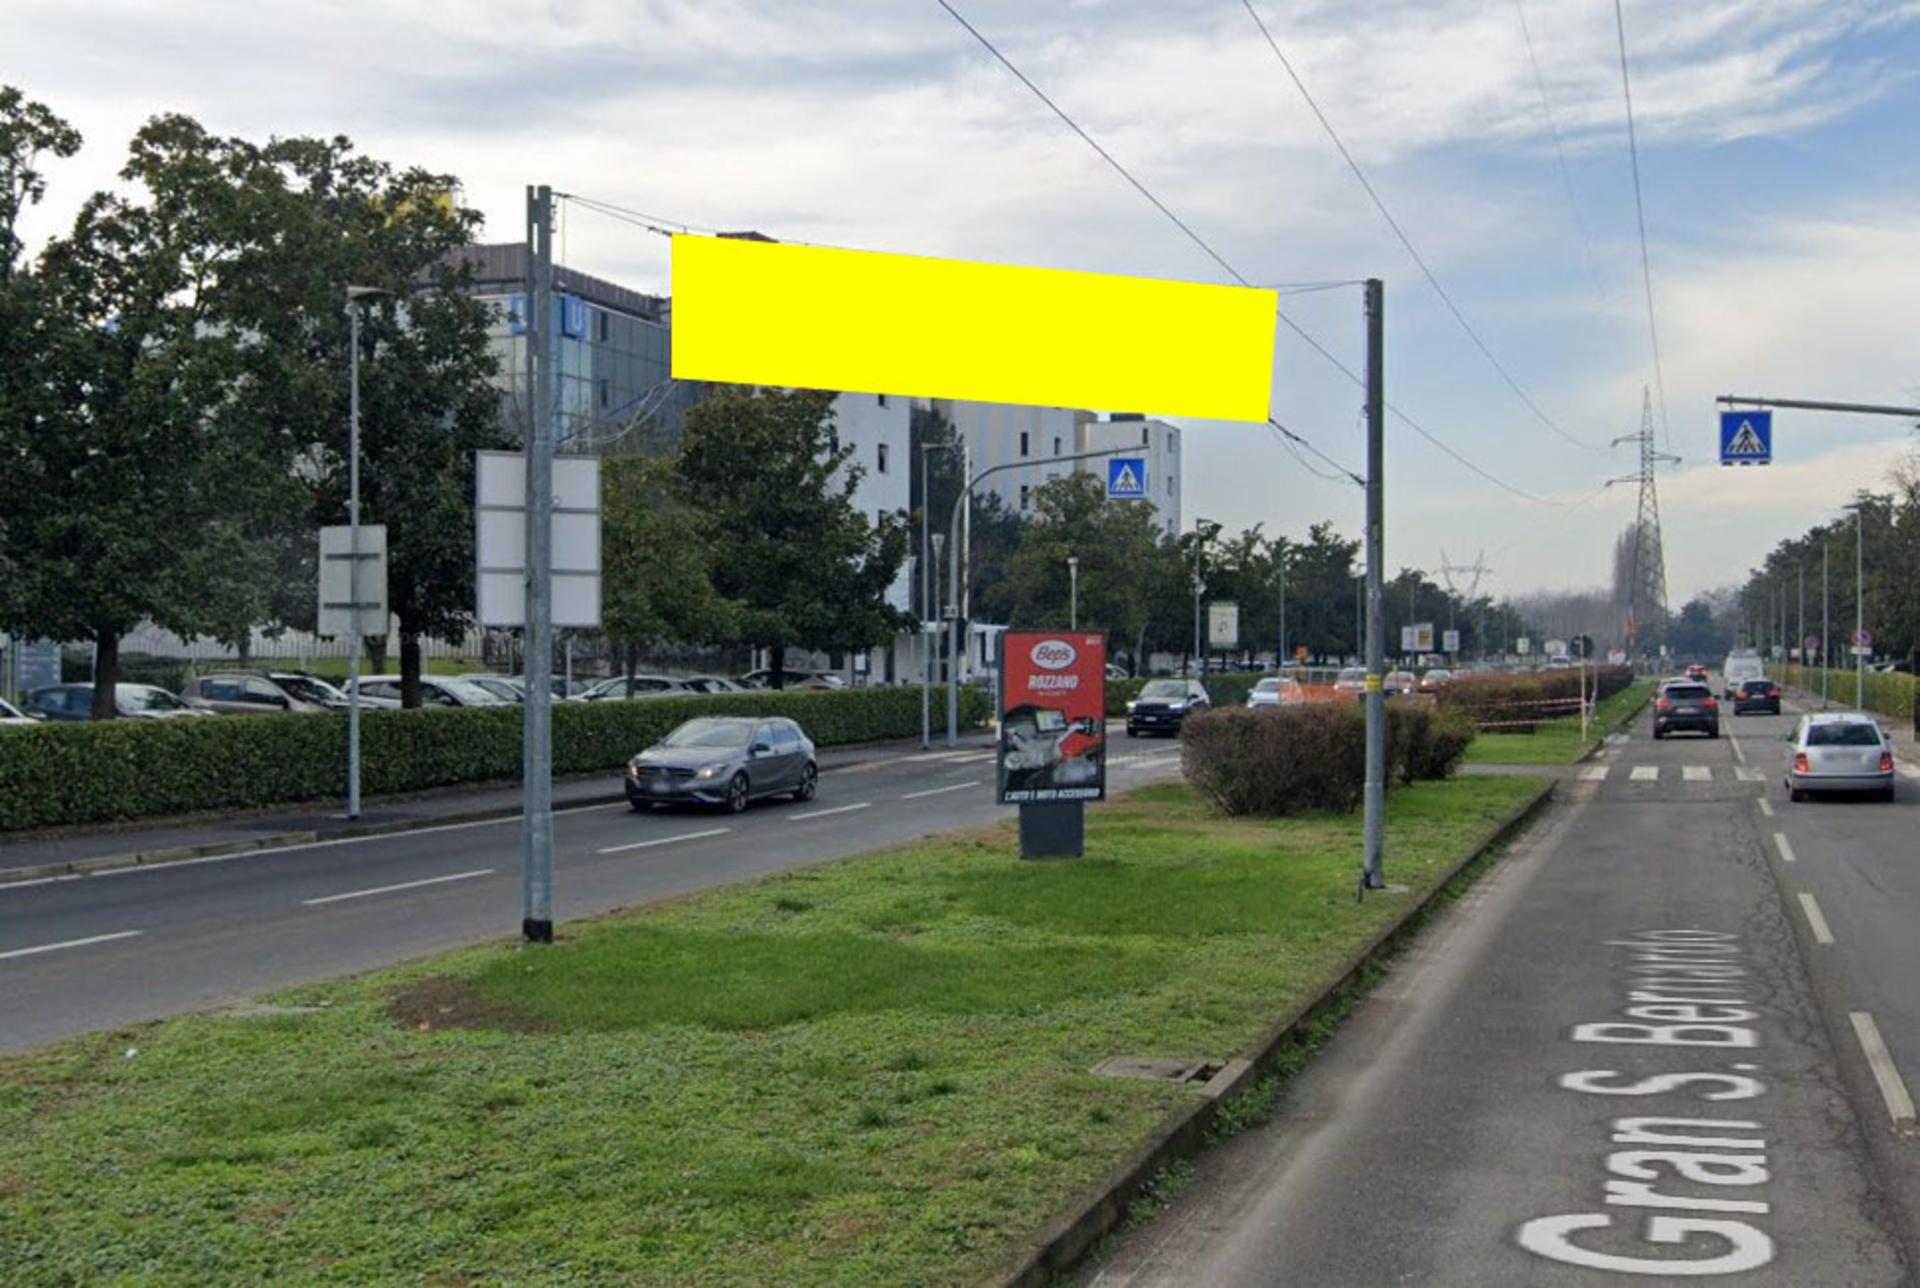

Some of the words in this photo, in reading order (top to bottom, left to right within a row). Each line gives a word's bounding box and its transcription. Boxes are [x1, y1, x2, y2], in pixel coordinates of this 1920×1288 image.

[1573, 929, 1760, 1048] Bernardo
[1560, 1063, 1767, 1100] S.
[1518, 1116, 1775, 1275] Gran
